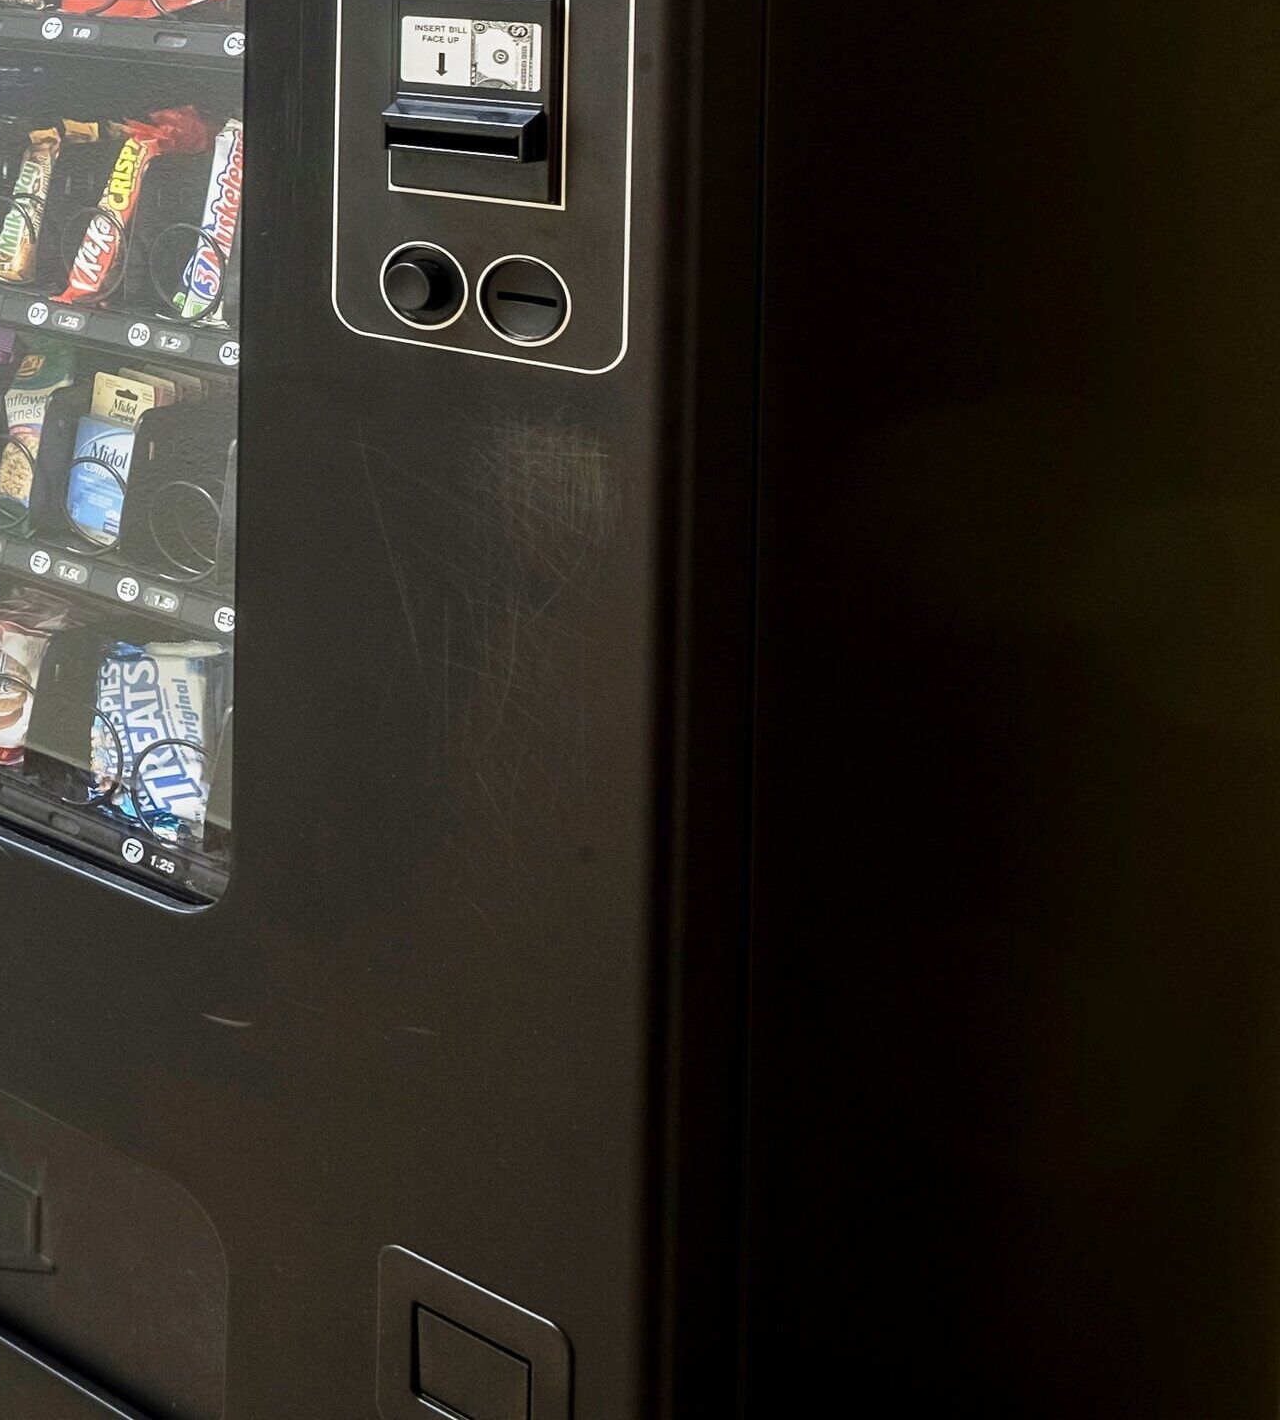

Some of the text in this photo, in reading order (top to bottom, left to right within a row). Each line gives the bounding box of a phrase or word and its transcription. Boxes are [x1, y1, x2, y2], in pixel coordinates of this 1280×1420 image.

[45, 21, 61, 34] C7
[414, 23, 468, 34] INSERT BILL
[226, 36, 245, 50] C9
[421, 35, 460, 44] FACE UP
[74, 214, 116, 282] KitKa
[194, 263, 220, 296] 3
[30, 307, 46, 319] D7
[130, 328, 147, 341] D8
[222, 346, 240, 360] D9
[111, 398, 138, 416] Midol
[90, 440, 129, 470] Midol
[32, 555, 48, 568] E7
[120, 583, 137, 596] E8
[217, 611, 235, 626] E9
[171, 678, 202, 746] Original
[123, 659, 202, 813] TREATS
[125, 842, 176, 874] F7 1.25
